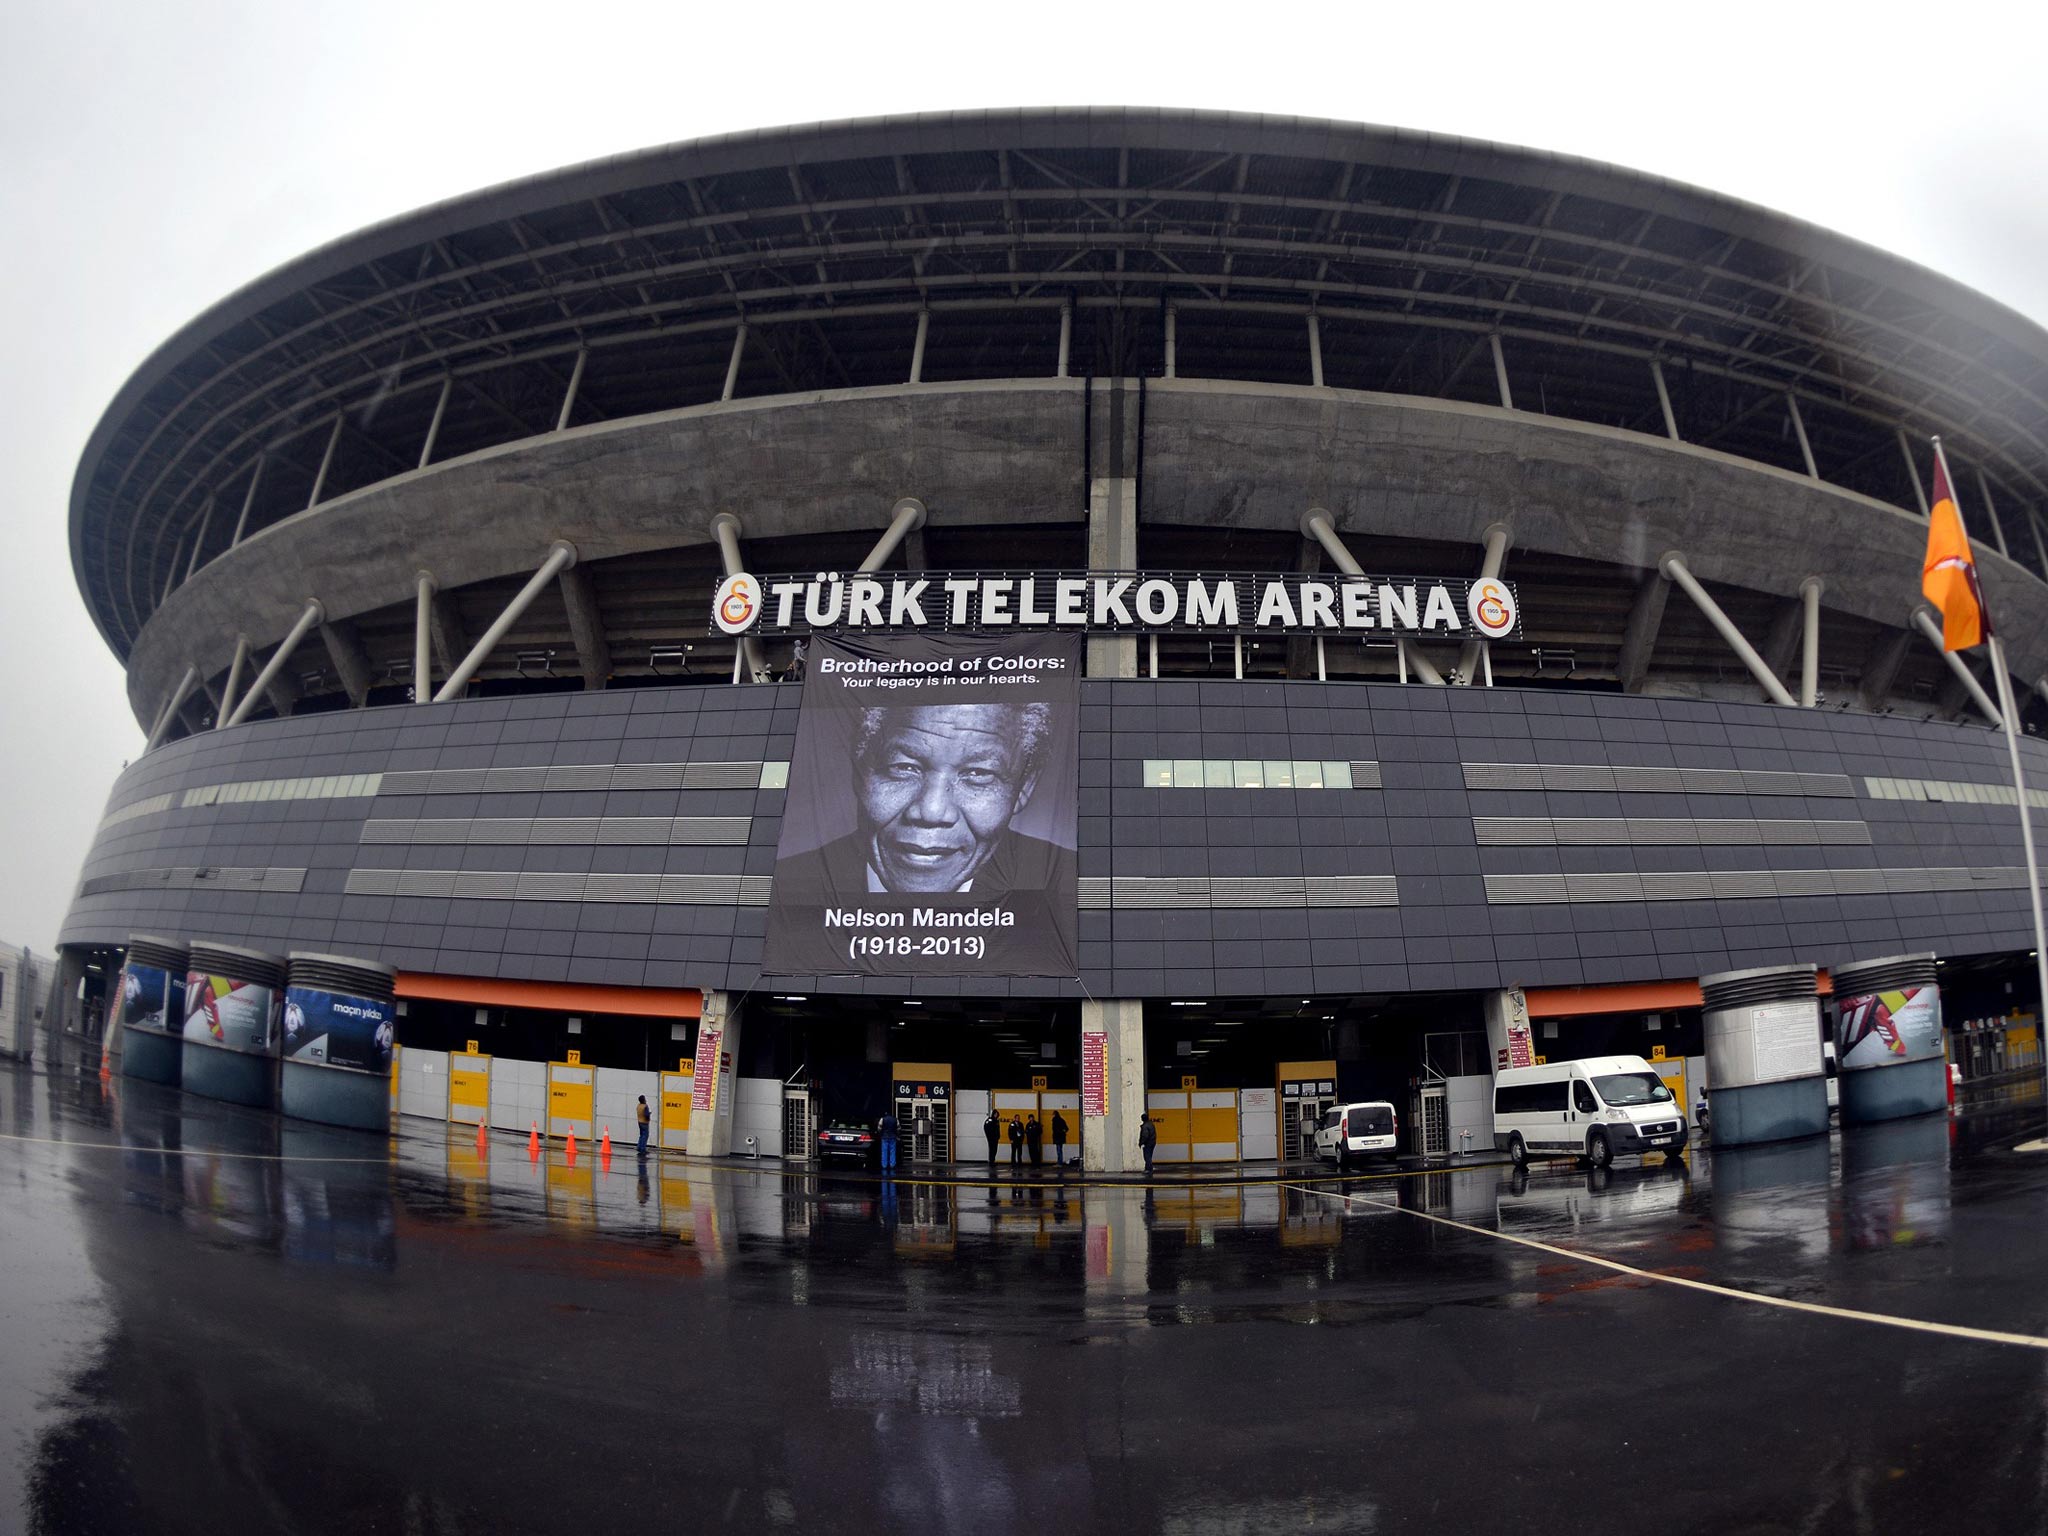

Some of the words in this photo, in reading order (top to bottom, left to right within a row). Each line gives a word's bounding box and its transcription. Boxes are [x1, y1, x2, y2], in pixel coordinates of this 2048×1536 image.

[771, 571, 930, 628] TÜRK
[944, 578, 1240, 626] TELEKOM
[1256, 582, 1463, 631] ARENA
[820, 656, 954, 673] Brotherhood
[959, 657, 982, 672] of
[987, 655, 1066, 670] Colors:
[841, 676, 875, 688] Your
[876, 676, 924, 689] legacy
[927, 675, 939, 686] is
[943, 675, 956, 685] in
[960, 676, 986, 685] our
[989, 674, 1040, 685] hearts.
[825, 908, 905, 927] Nelson
[912, 907, 1015, 927] Mandela
[849, 936, 986, 959] (1918-2013)
[468, 1042, 477, 1051] 76
[1654, 1047, 1664, 1056] 84
[569, 1052, 579, 1061] 77
[681, 1060, 692, 1070] 78
[1033, 1078, 1046, 1086] 80
[1183, 1078, 1195, 1086] 81
[899, 1084, 911, 1094] G6
[933, 1085, 945, 1095] G6
